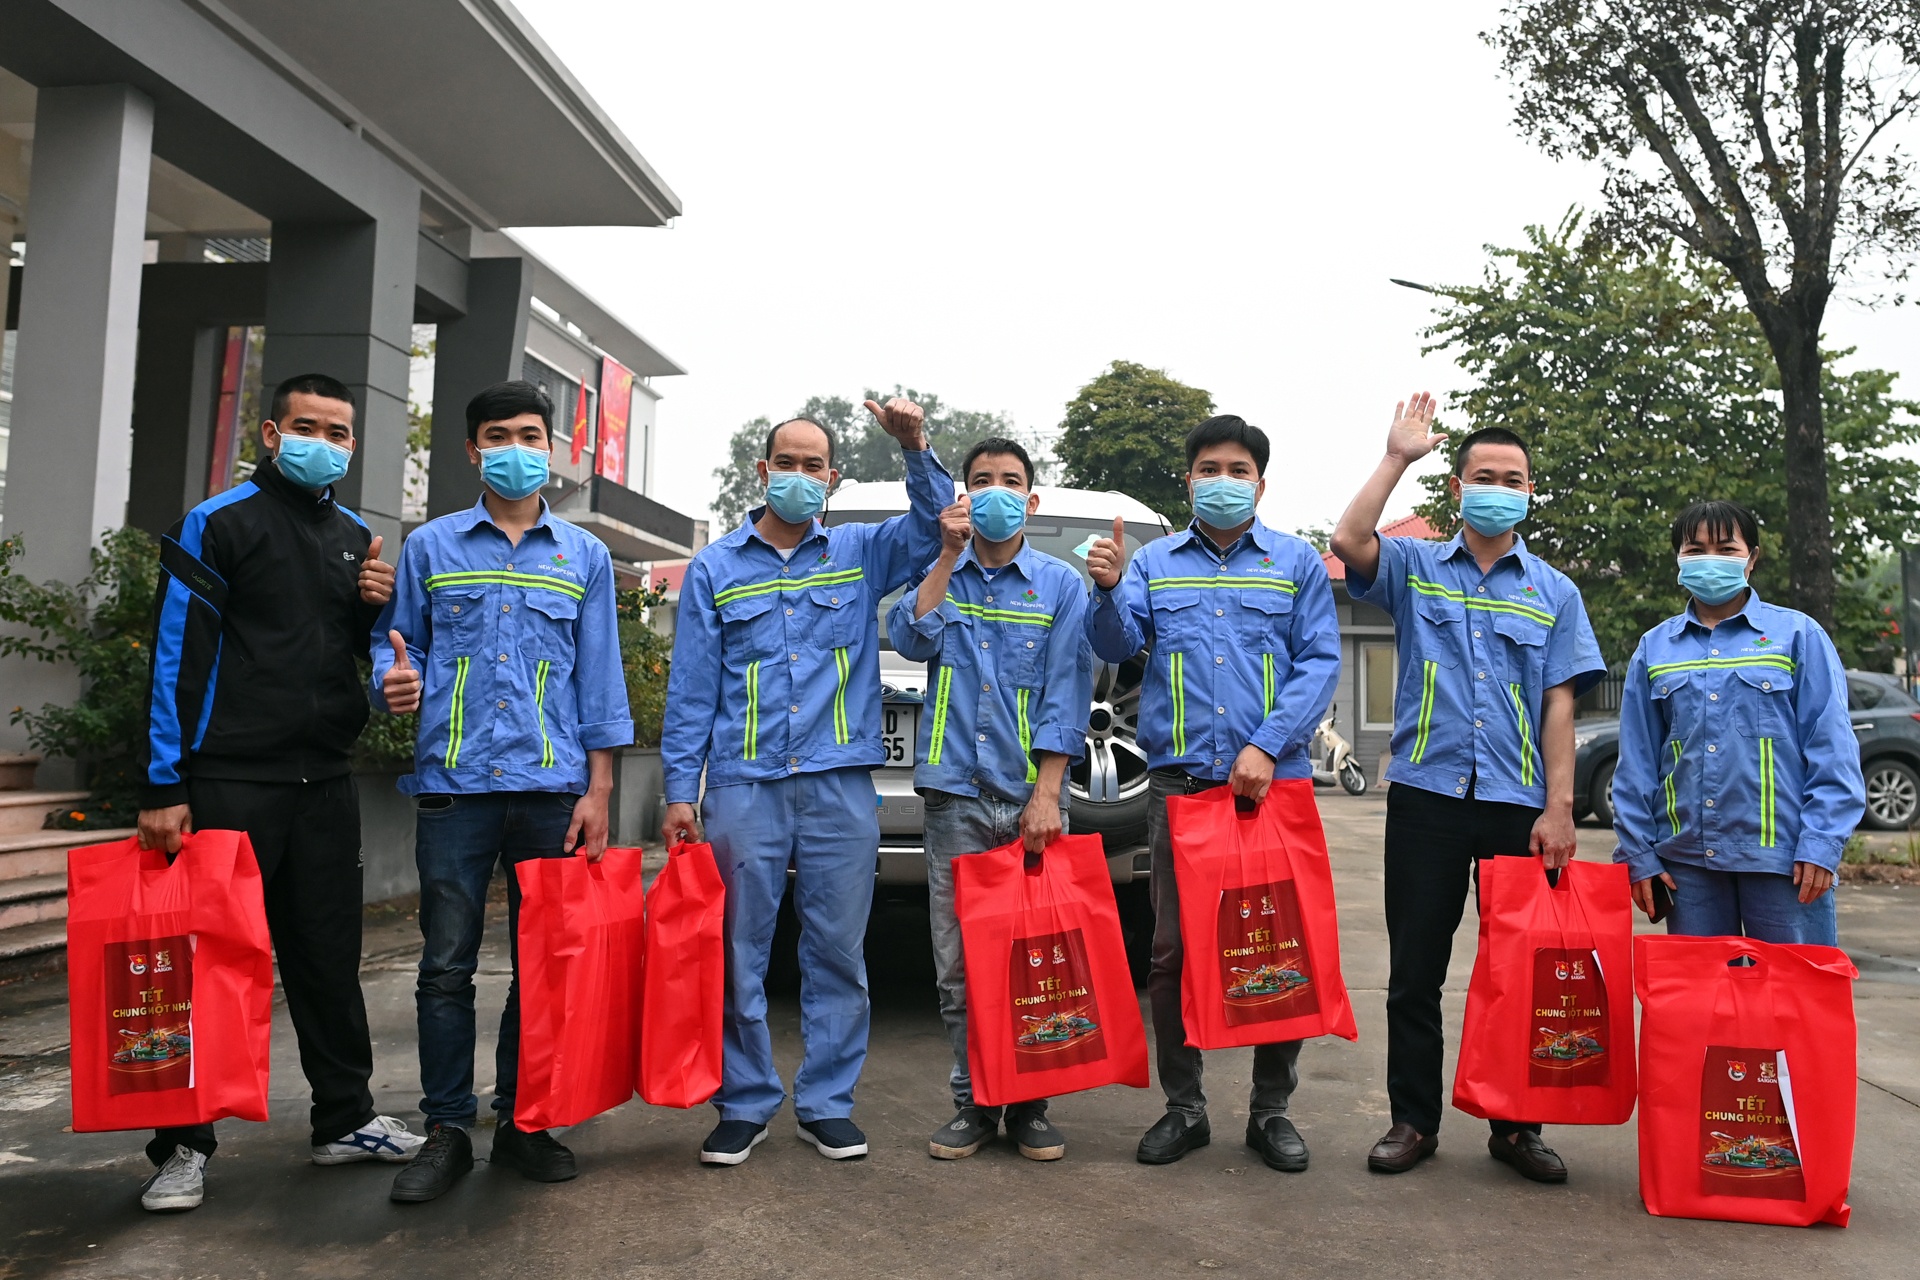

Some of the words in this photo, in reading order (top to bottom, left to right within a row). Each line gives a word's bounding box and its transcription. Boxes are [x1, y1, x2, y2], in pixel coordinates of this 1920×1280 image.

[881, 709, 898, 735] D
[1247, 927, 1270, 944] TẾT
[1223, 946, 1255, 957] CHUNG
[1256, 942, 1277, 954] MỘT
[1278, 937, 1299, 950] NHÀ
[1038, 975, 1061, 992] TẾT
[139, 986, 164, 1003] TẾT
[1014, 994, 1046, 1006] CHUNG
[1048, 990, 1067, 1003] MỘT
[1068, 985, 1088, 998] NHÀ
[1560, 992, 1577, 1007] TT
[112, 1006, 147, 1018] CHUNG
[172, 999, 192, 1012] NHÀ
[1535, 1008, 1566, 1018] CHUNG
[1568, 1007, 1582, 1019] ỘT
[1583, 1006, 1601, 1017] NHÀ
[1736, 1094, 1766, 1111] TẾT
[1704, 1111, 1744, 1122] CHUNG
[1747, 1112, 1772, 1126] MỘT
[1775, 1115, 1789, 1124] NH
